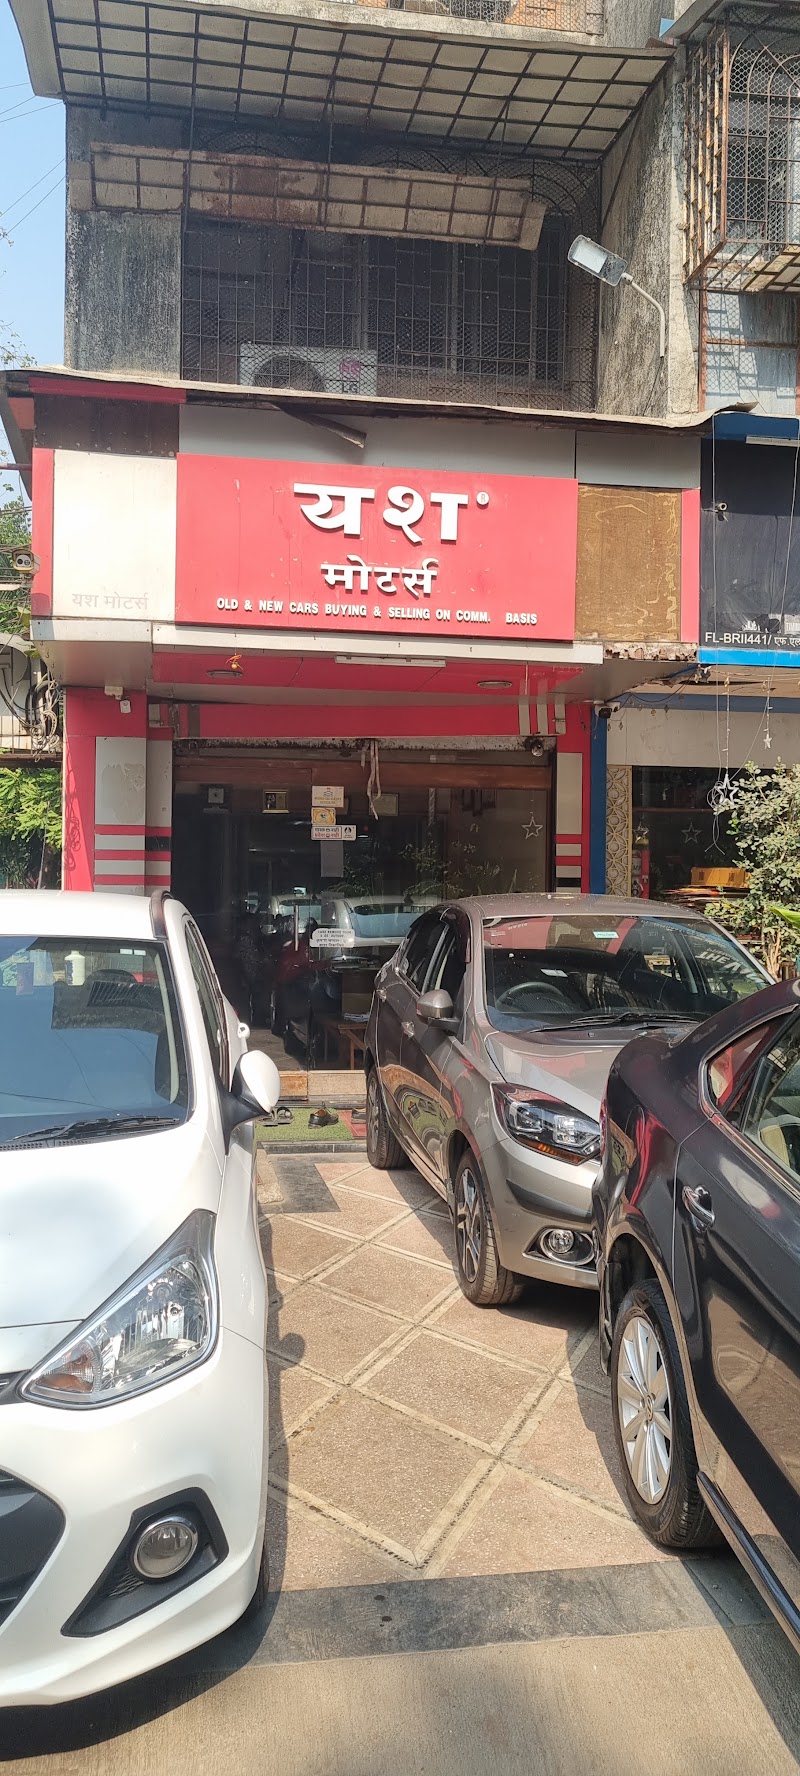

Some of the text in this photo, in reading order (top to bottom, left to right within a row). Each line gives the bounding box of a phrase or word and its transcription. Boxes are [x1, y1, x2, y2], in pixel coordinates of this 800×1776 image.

[294, 483, 468, 543] यश
[320, 555, 439, 598] मोटर्स
[72, 592, 149, 610] यश मोटर्स
[216, 598, 538, 625] OLD & NEW CARS BUYING & SELLING ON COMM. BASIS
